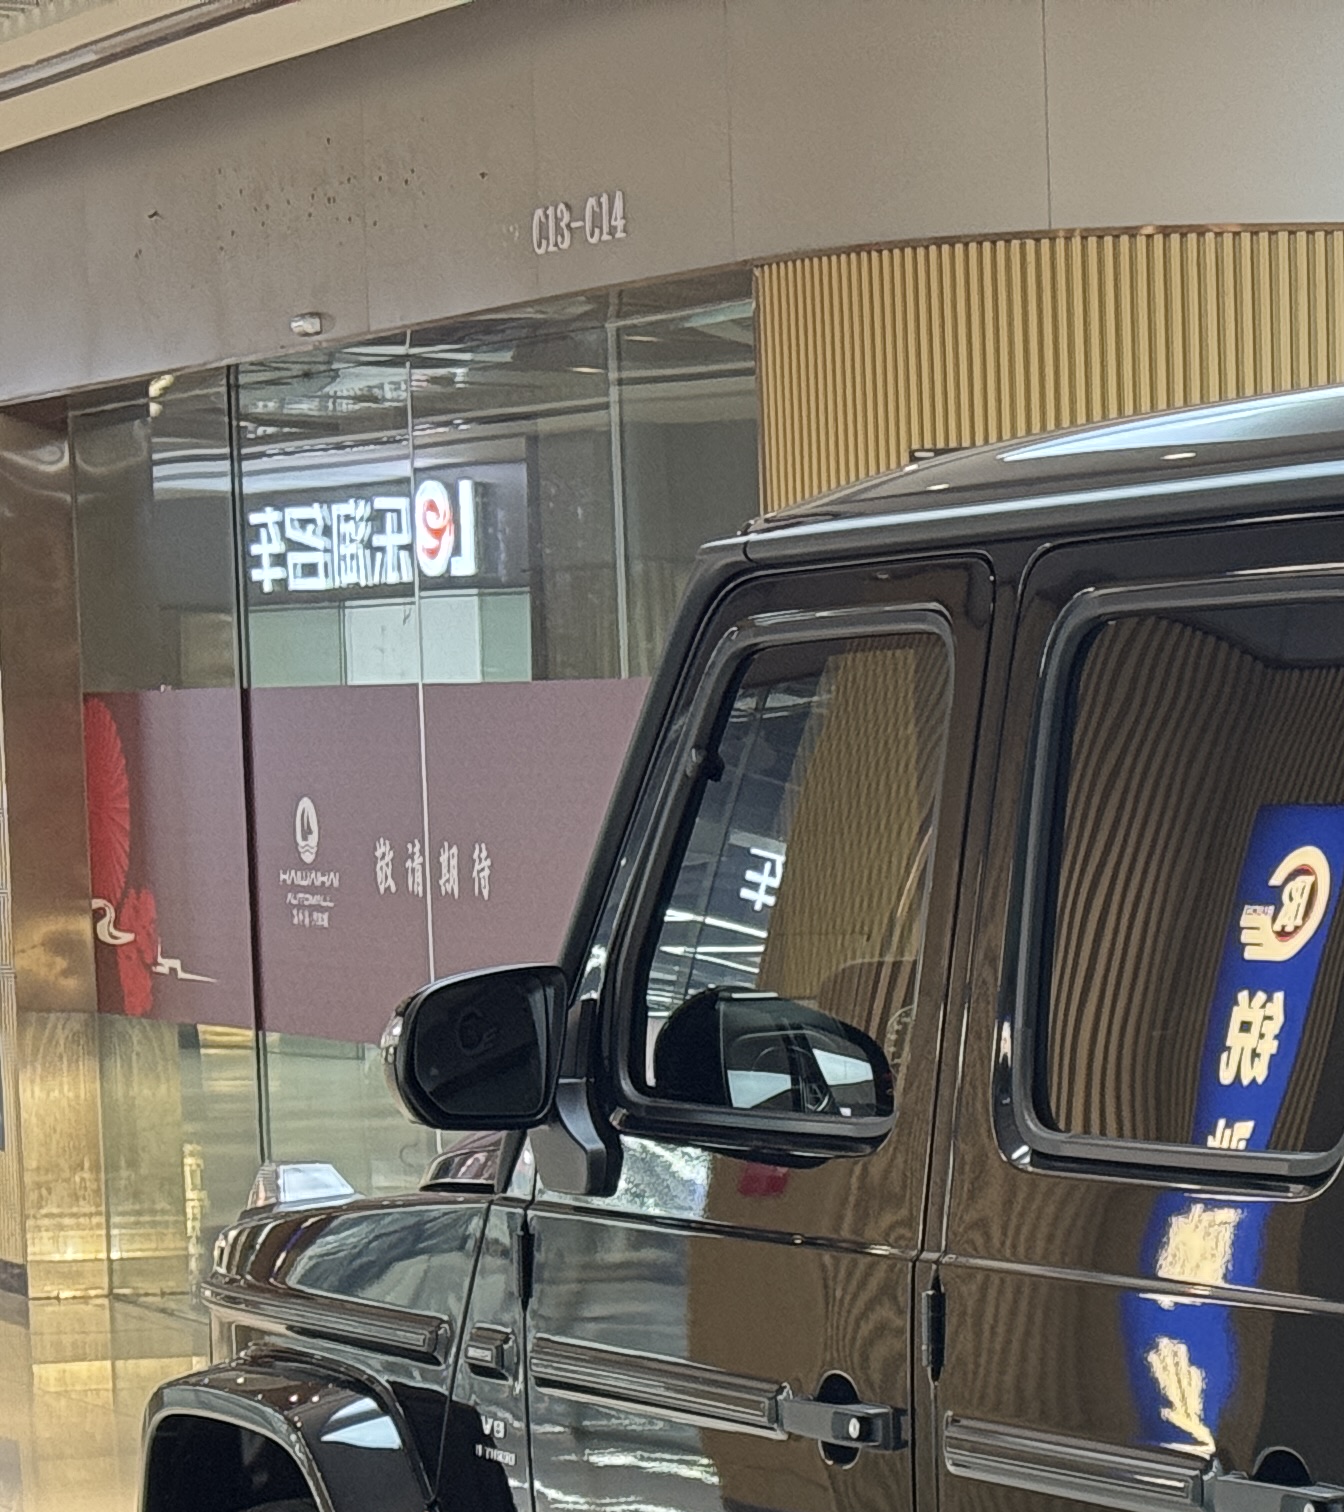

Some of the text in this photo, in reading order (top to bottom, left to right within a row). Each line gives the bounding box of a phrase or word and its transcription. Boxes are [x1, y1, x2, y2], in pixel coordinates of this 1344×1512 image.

[531, 190, 627, 255] C13-C14
[373, 836, 493, 901] 敬请期待
[481, 1415, 505, 1438] V8
